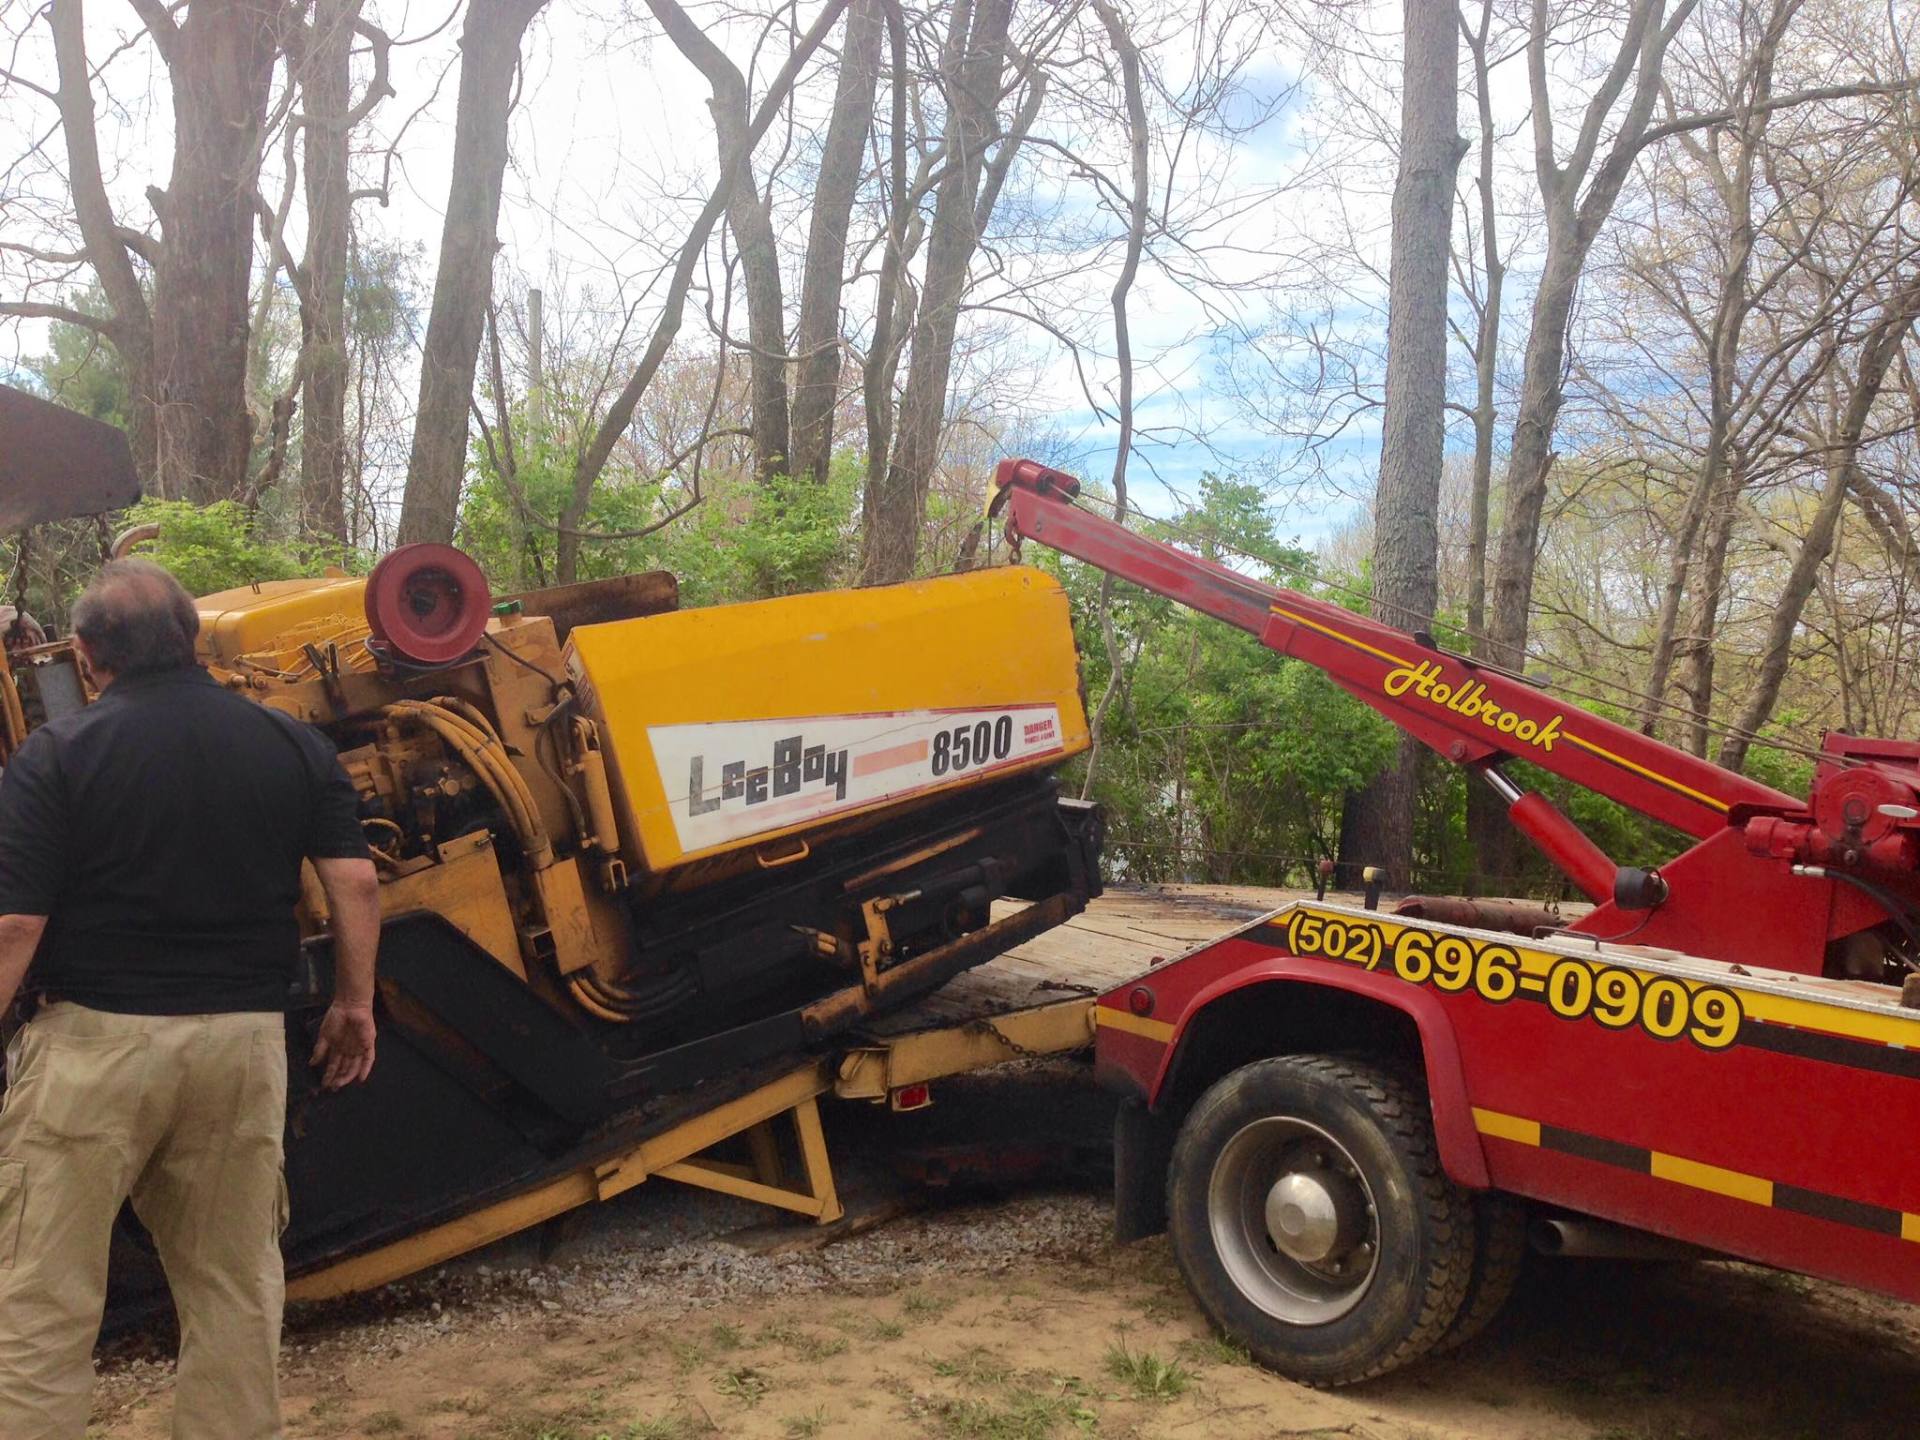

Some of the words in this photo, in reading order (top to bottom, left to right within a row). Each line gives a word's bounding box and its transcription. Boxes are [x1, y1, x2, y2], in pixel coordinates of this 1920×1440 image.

[1384, 660, 1563, 752] Holbrook
[689, 735, 849, 818] LeeBoy
[931, 714, 1013, 777] 8500
[1288, 912, 1382, 971] (502)
[1394, 930, 1743, 1049] 696-0909
